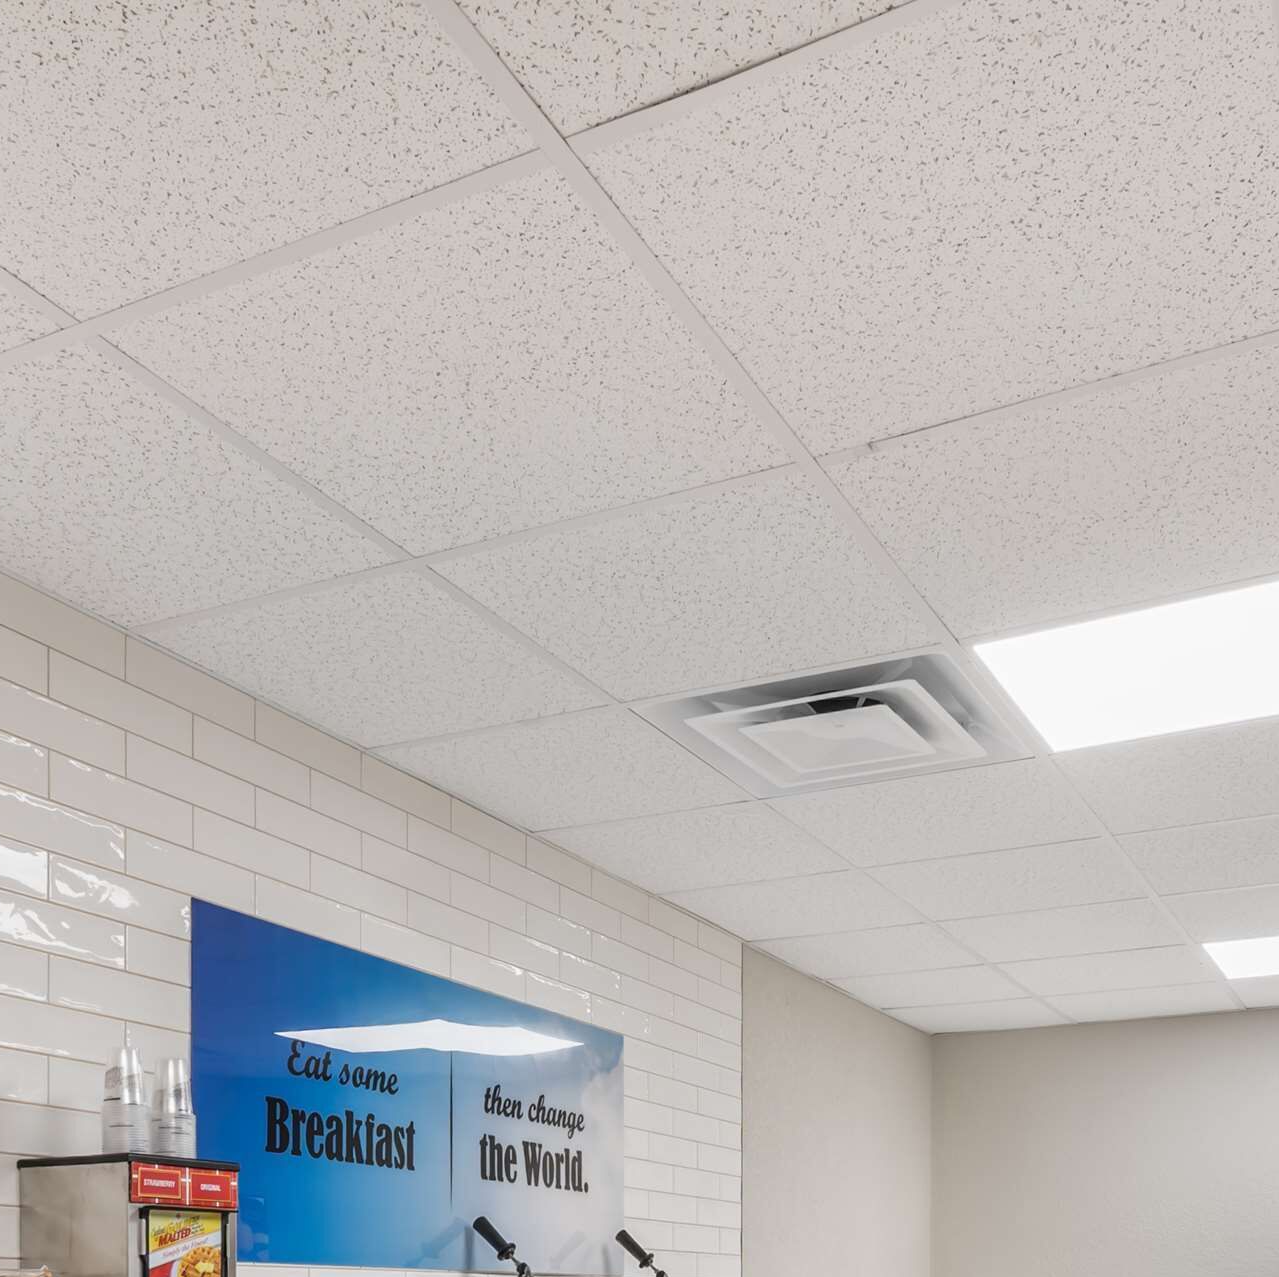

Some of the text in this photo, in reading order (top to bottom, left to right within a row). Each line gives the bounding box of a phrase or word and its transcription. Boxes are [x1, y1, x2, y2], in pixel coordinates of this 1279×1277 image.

[287, 1039, 399, 1095] Eat some
[265, 1096, 416, 1171] Breakfast
[484, 1084, 585, 1139] then change
[479, 1133, 589, 1193] the World.
